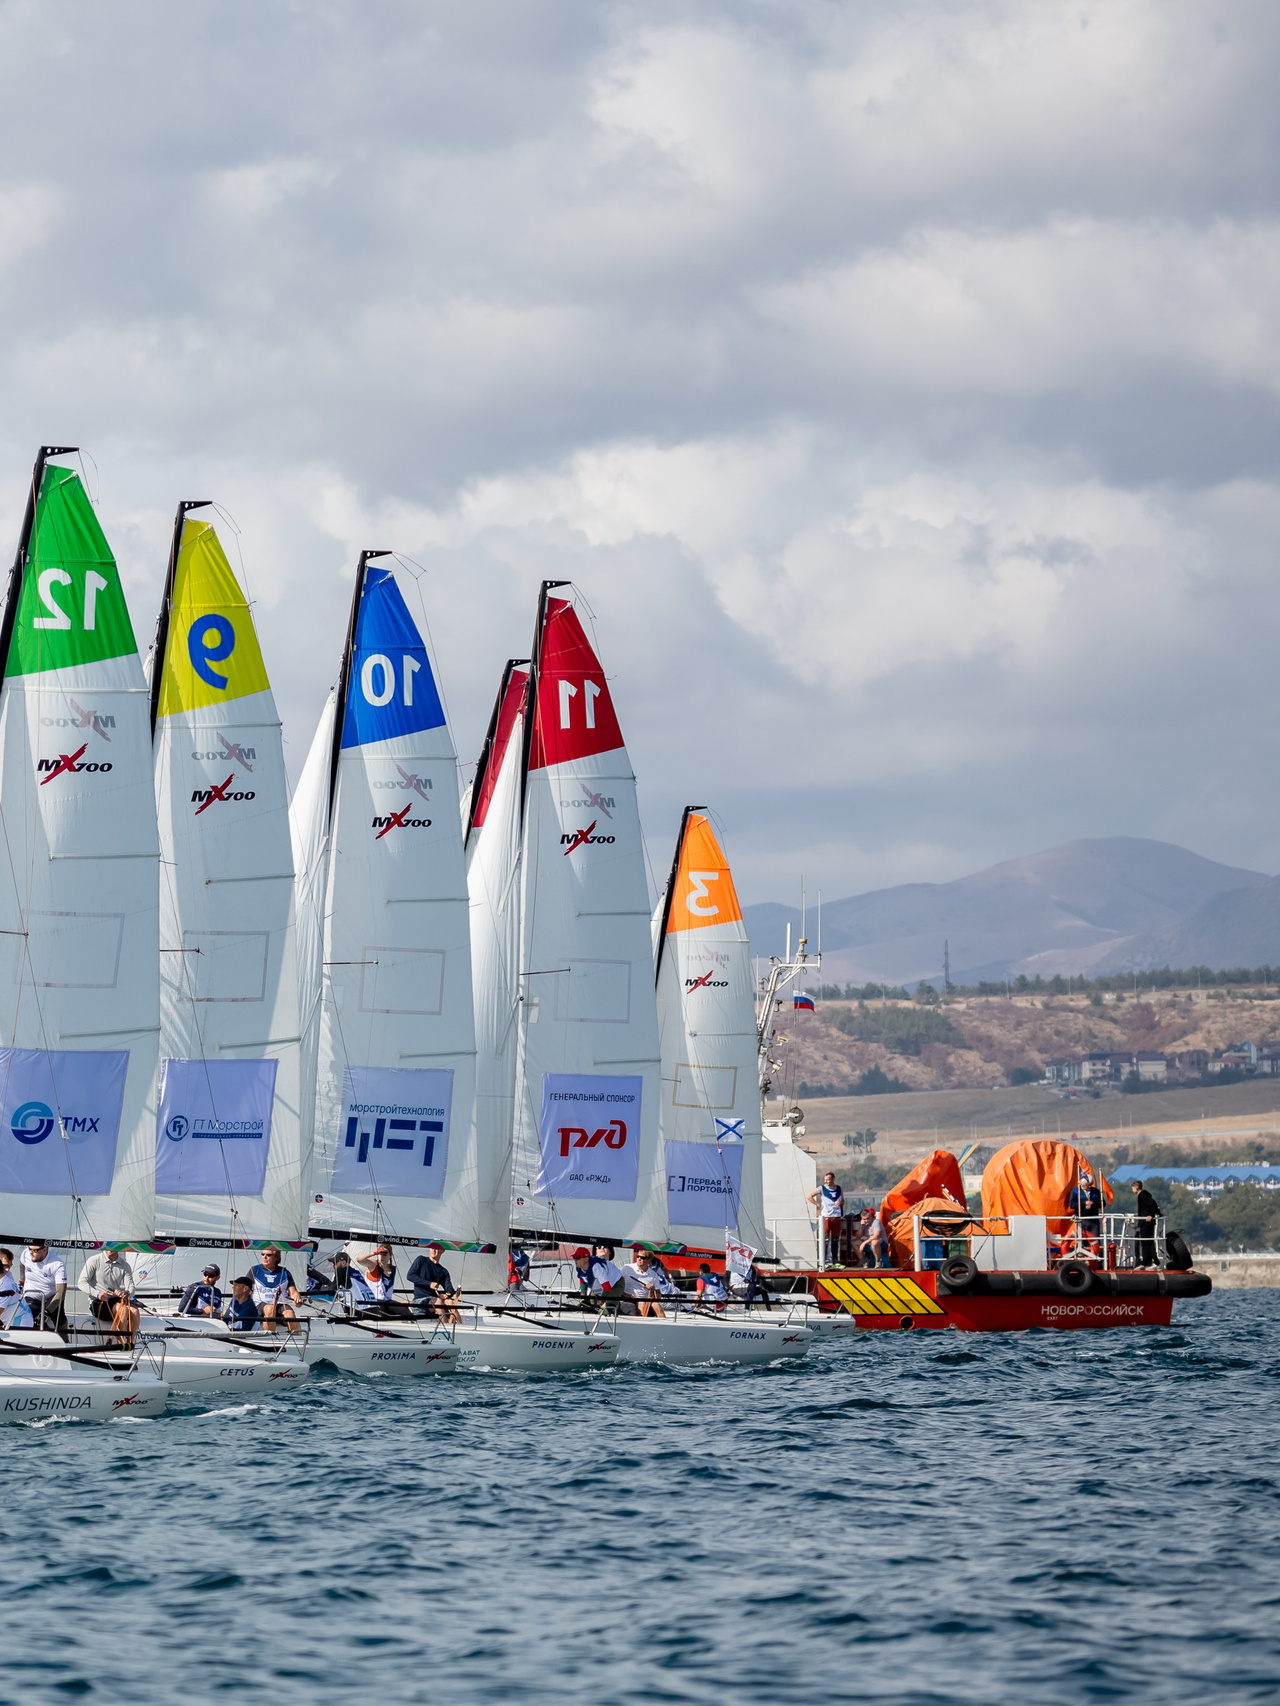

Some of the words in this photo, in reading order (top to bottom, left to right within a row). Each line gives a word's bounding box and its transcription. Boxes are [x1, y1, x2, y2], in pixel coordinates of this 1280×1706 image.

[37, 743, 113, 786] MX700
[191, 773, 256, 816] MX700
[371, 802, 433, 840] MX700
[560, 819, 616, 856] MX700
[685, 969, 729, 994] MX700
[550, 1092, 605, 1102] ГЕНЕРАЛЬНЫЙ
[606, 1094, 635, 1103] СПОНСОР
[349, 1103, 445, 1117] морстройтехнология
[193, 1119, 206, 1130] ГТ
[208, 1119, 264, 1133] Морстрой
[688, 1177, 722, 1187] ПЕРВАЯ
[687, 1184, 733, 1195] ПОРТОВАЯ
[53, 1239, 96, 1249] wind_to_go
[196, 1239, 232, 1247] wind_to_go
[384, 1236, 419, 1245] wind_to_go
[1041, 1304, 1144, 1315] НОВОРОССИЙСК
[730, 1331, 767, 1340] FORNAX
[531, 1340, 576, 1349] PHOENIX
[371, 1352, 416, 1361] PROXIMA
[220, 1368, 255, 1377] CETUS
[4, 1396, 92, 1412] KUSHINDA
